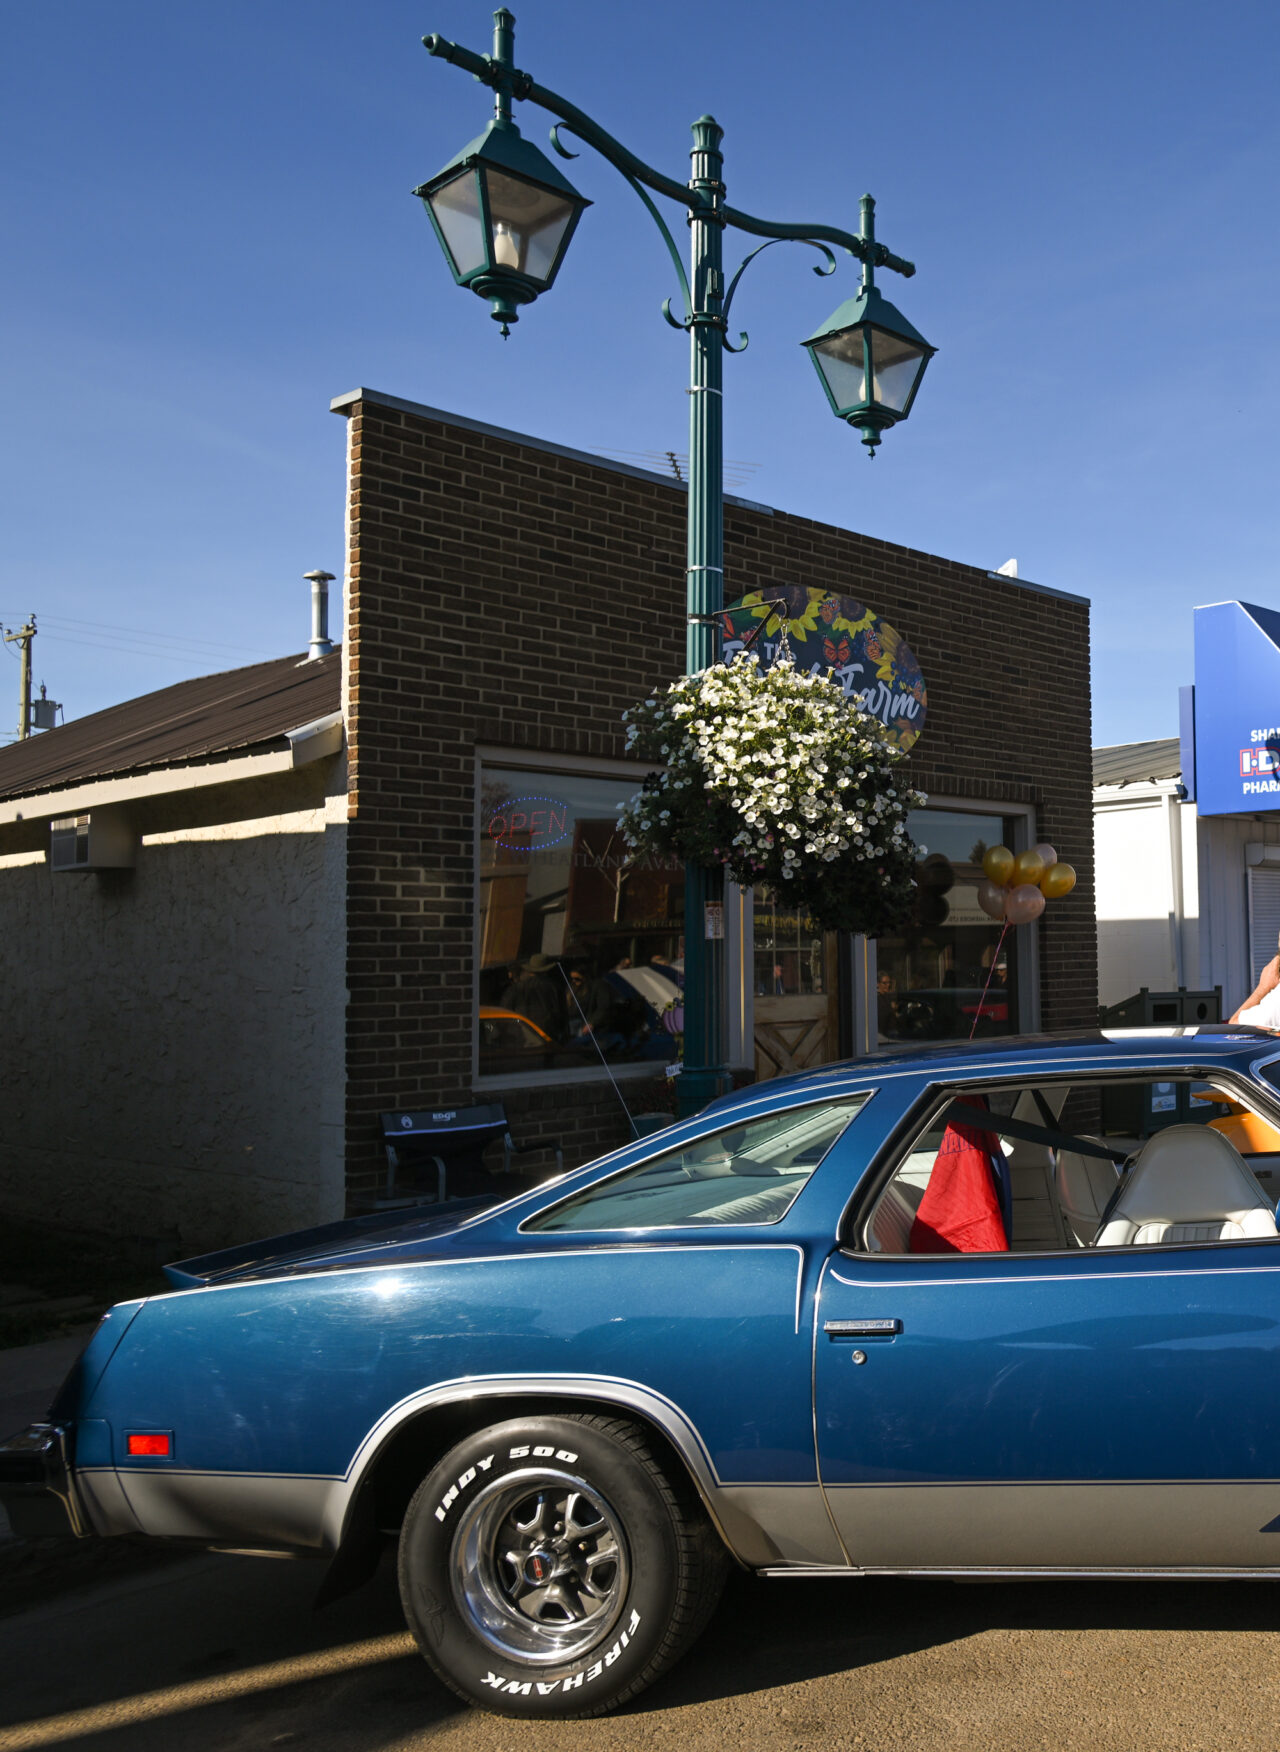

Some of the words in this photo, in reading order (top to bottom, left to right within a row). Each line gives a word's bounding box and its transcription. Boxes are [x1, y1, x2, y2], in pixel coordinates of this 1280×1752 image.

[834, 662, 920, 726] Farm
[488, 807, 568, 840] OPEN
[640, 854, 686, 871] AVEN
[434, 1454, 495, 1522] INDY
[509, 1445, 579, 1464] 500
[480, 1608, 642, 1695] FIREHAWK
